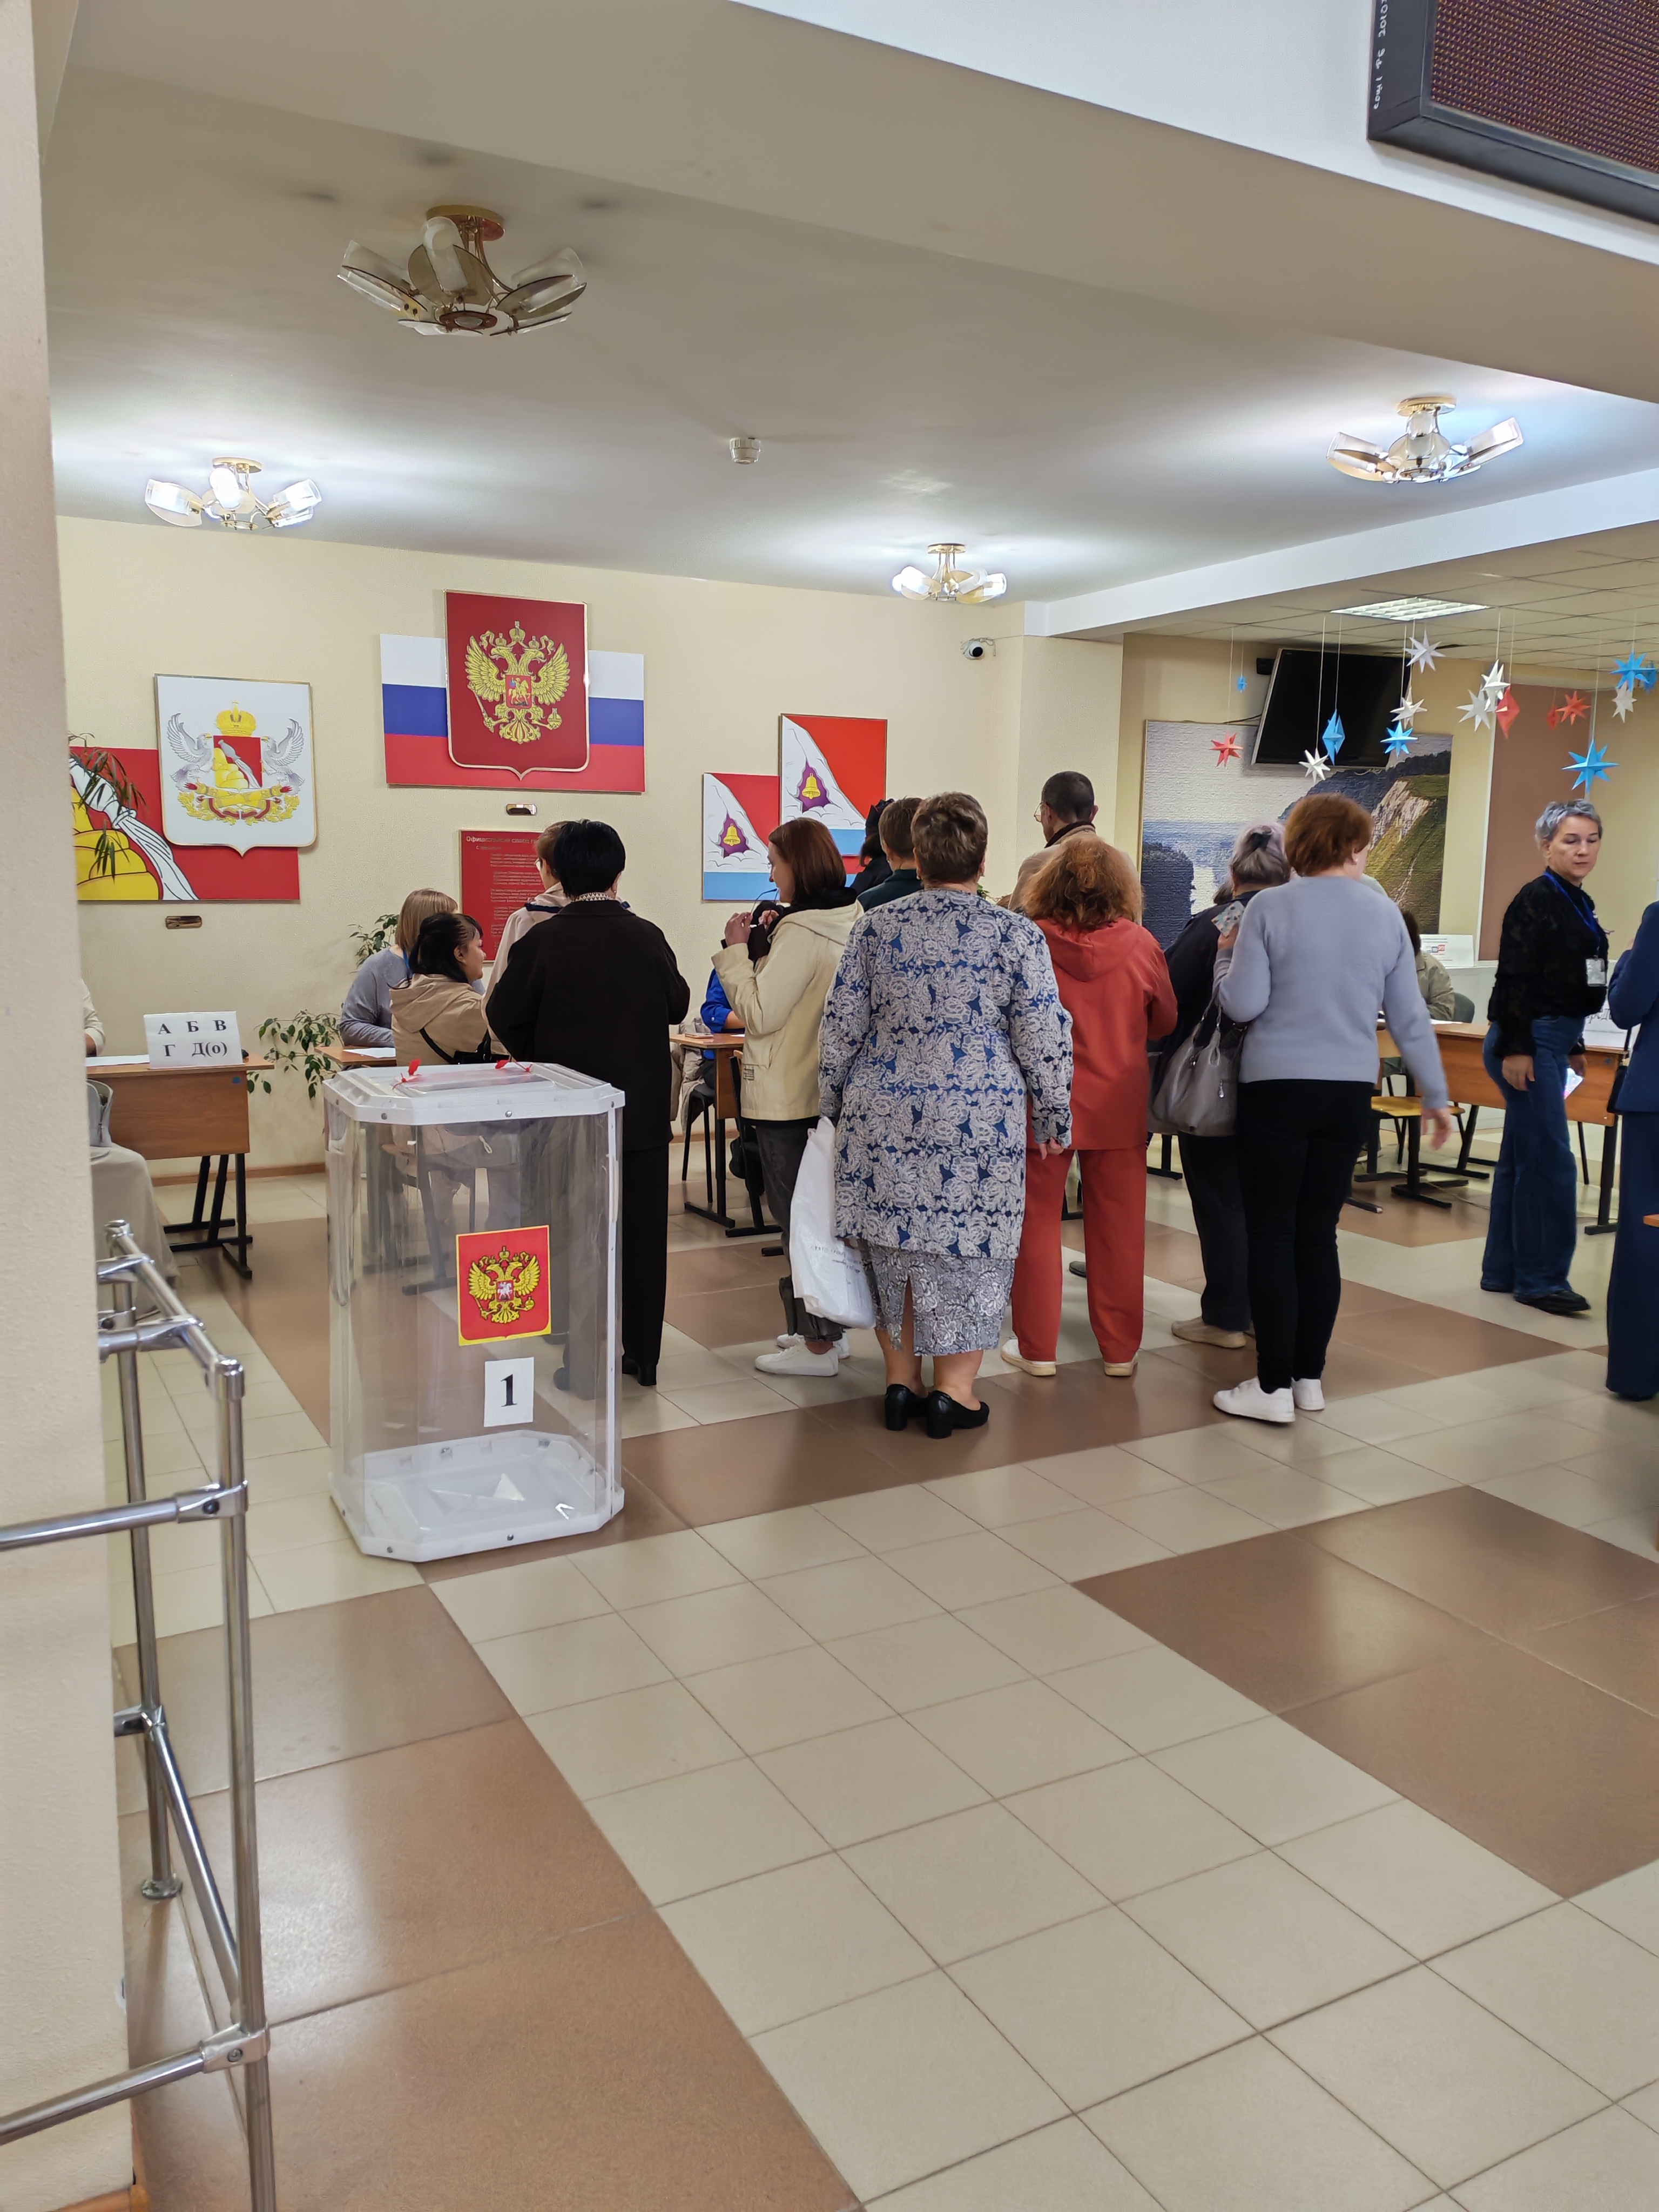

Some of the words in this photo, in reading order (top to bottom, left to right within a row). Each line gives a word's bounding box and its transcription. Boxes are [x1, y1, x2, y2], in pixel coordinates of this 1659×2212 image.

[158, 1023, 172, 1034] А
[186, 1021, 199, 1032] Б
[213, 1020, 226, 1031] В
[164, 1044, 176, 1056] Г
[192, 1041, 227, 1057] Д(о)
[501, 1374, 517, 1407] 1
